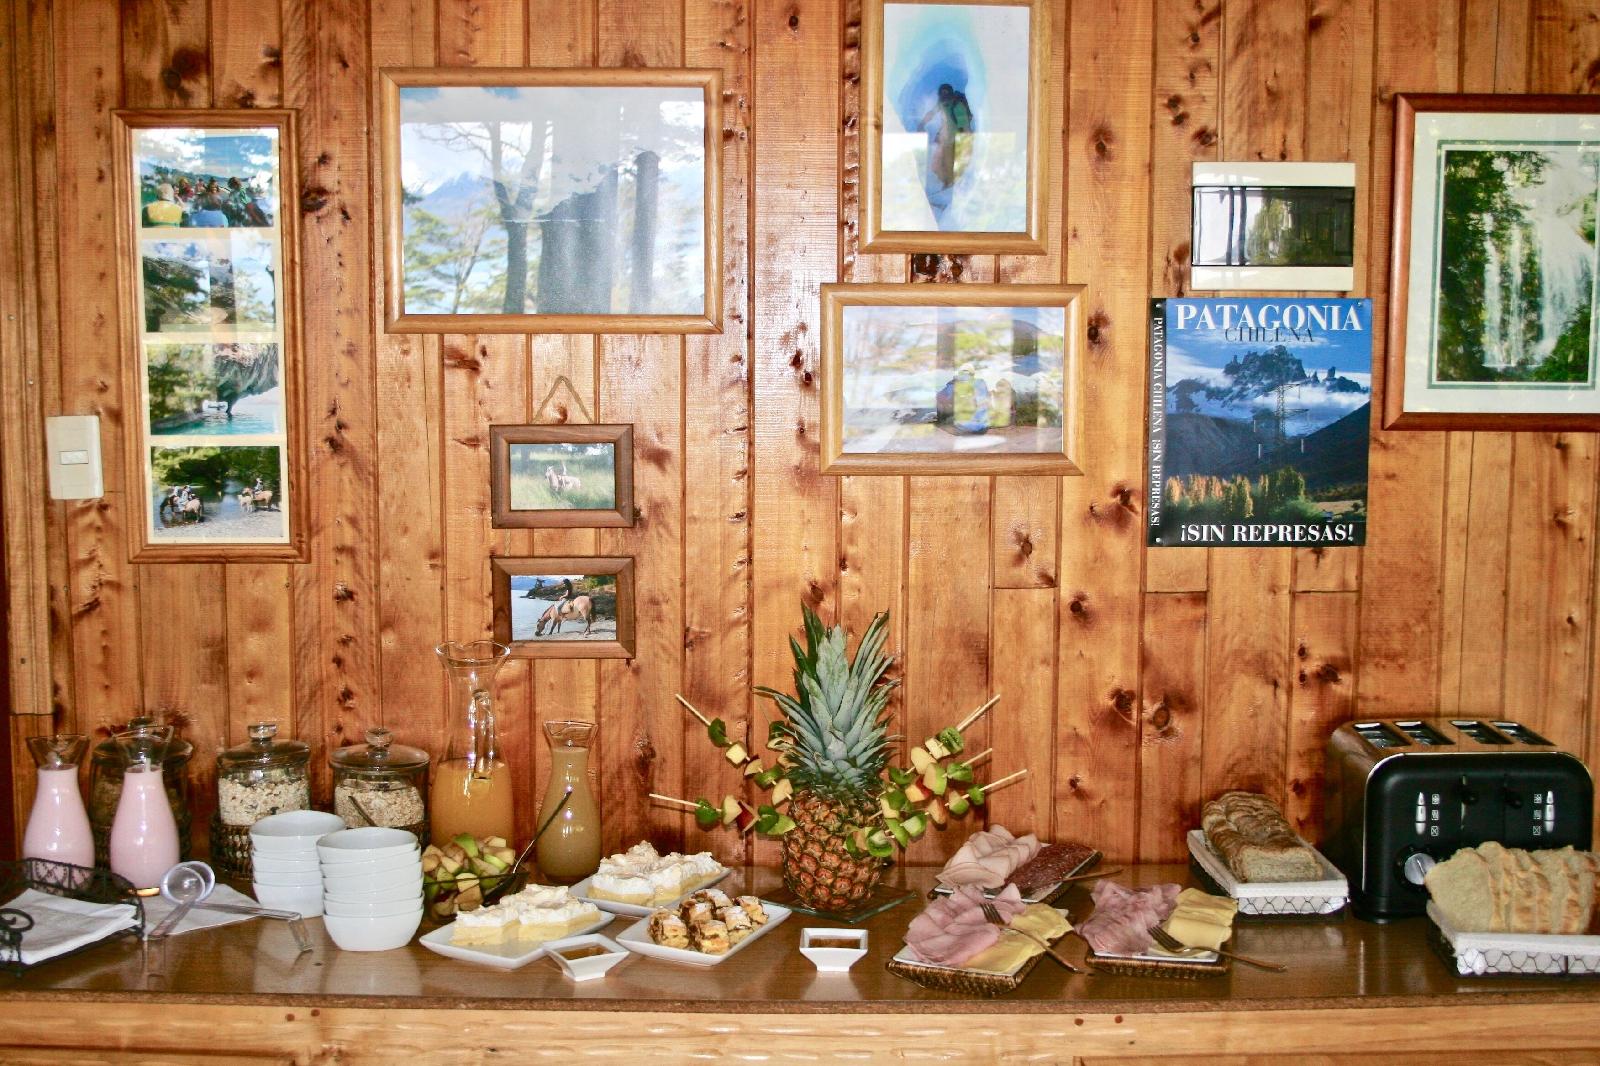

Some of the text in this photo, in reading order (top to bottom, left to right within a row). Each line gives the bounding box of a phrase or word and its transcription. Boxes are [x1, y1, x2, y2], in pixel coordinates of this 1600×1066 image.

[1175, 303, 1363, 331] PATAGONIA
[1224, 326, 1315, 343] CHILENA
[1150, 317, 1164, 526] PATAGONIA CHILENA ¡SIN REPRESAS!
[1181, 524, 1354, 542] ¡SIN REPRESAS!
